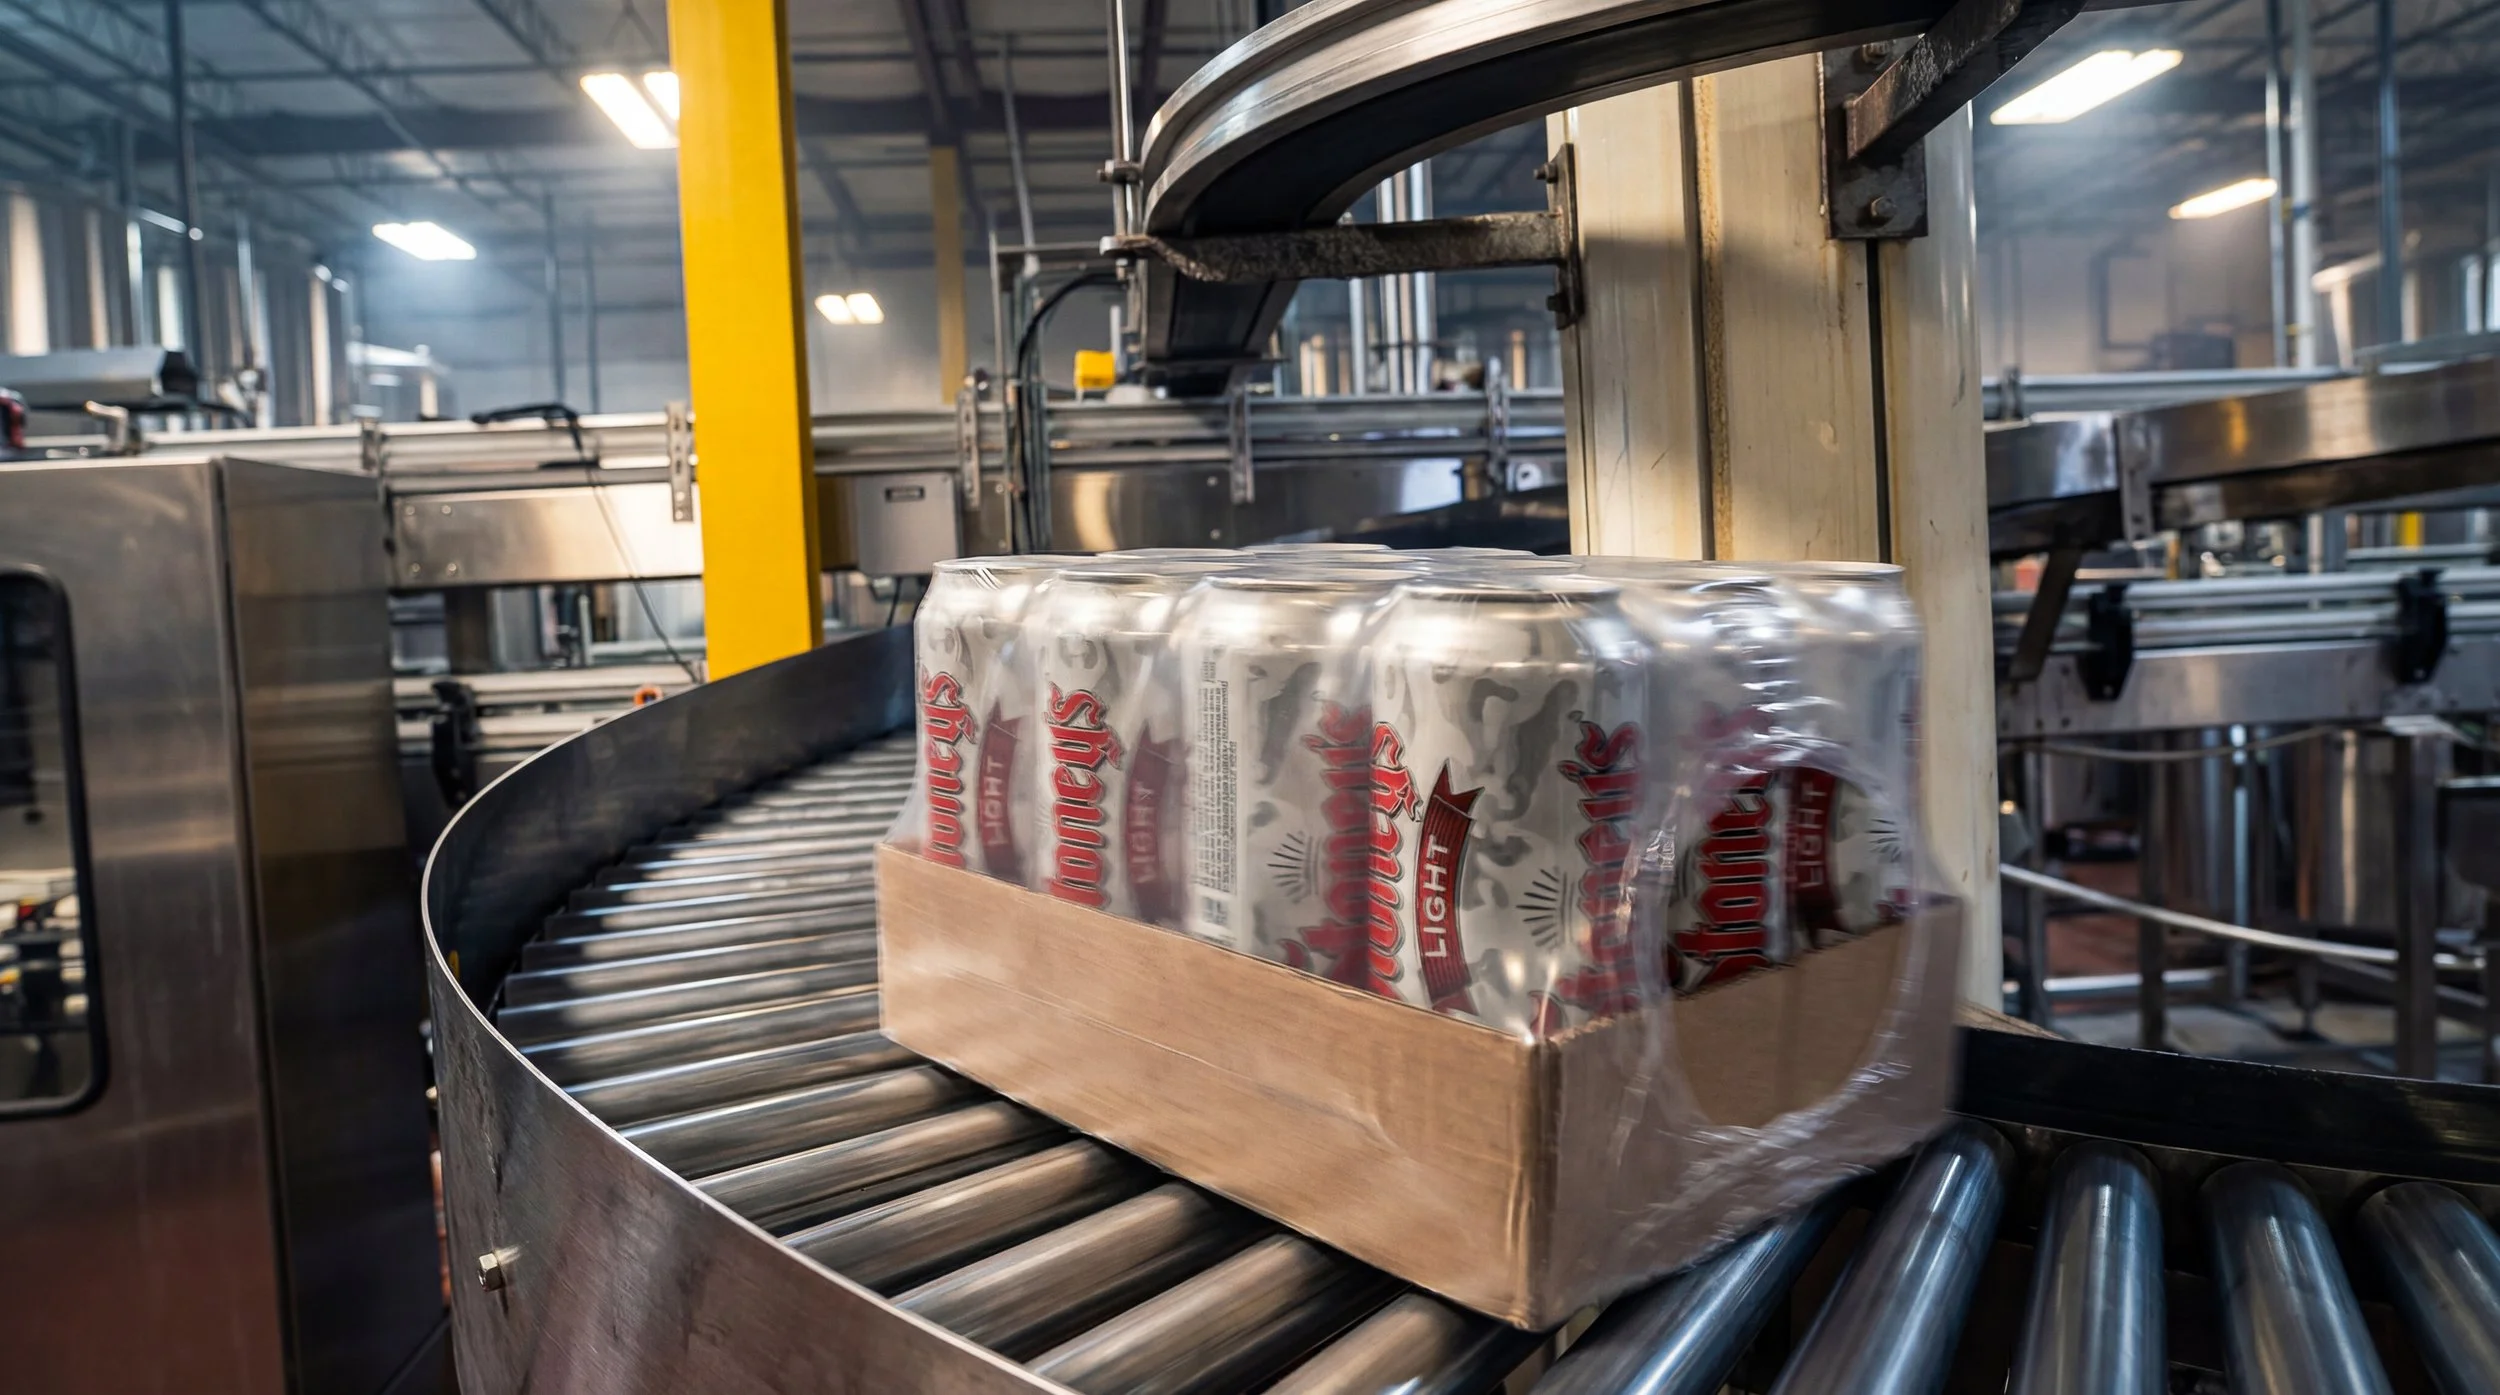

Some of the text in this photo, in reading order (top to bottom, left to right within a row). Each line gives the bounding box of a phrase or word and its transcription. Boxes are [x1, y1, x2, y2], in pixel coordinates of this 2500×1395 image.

[982, 754, 1006, 847] LIGHT
[1799, 778, 1829, 889] LIGHT
[1422, 834, 1450, 958] LIGHT
